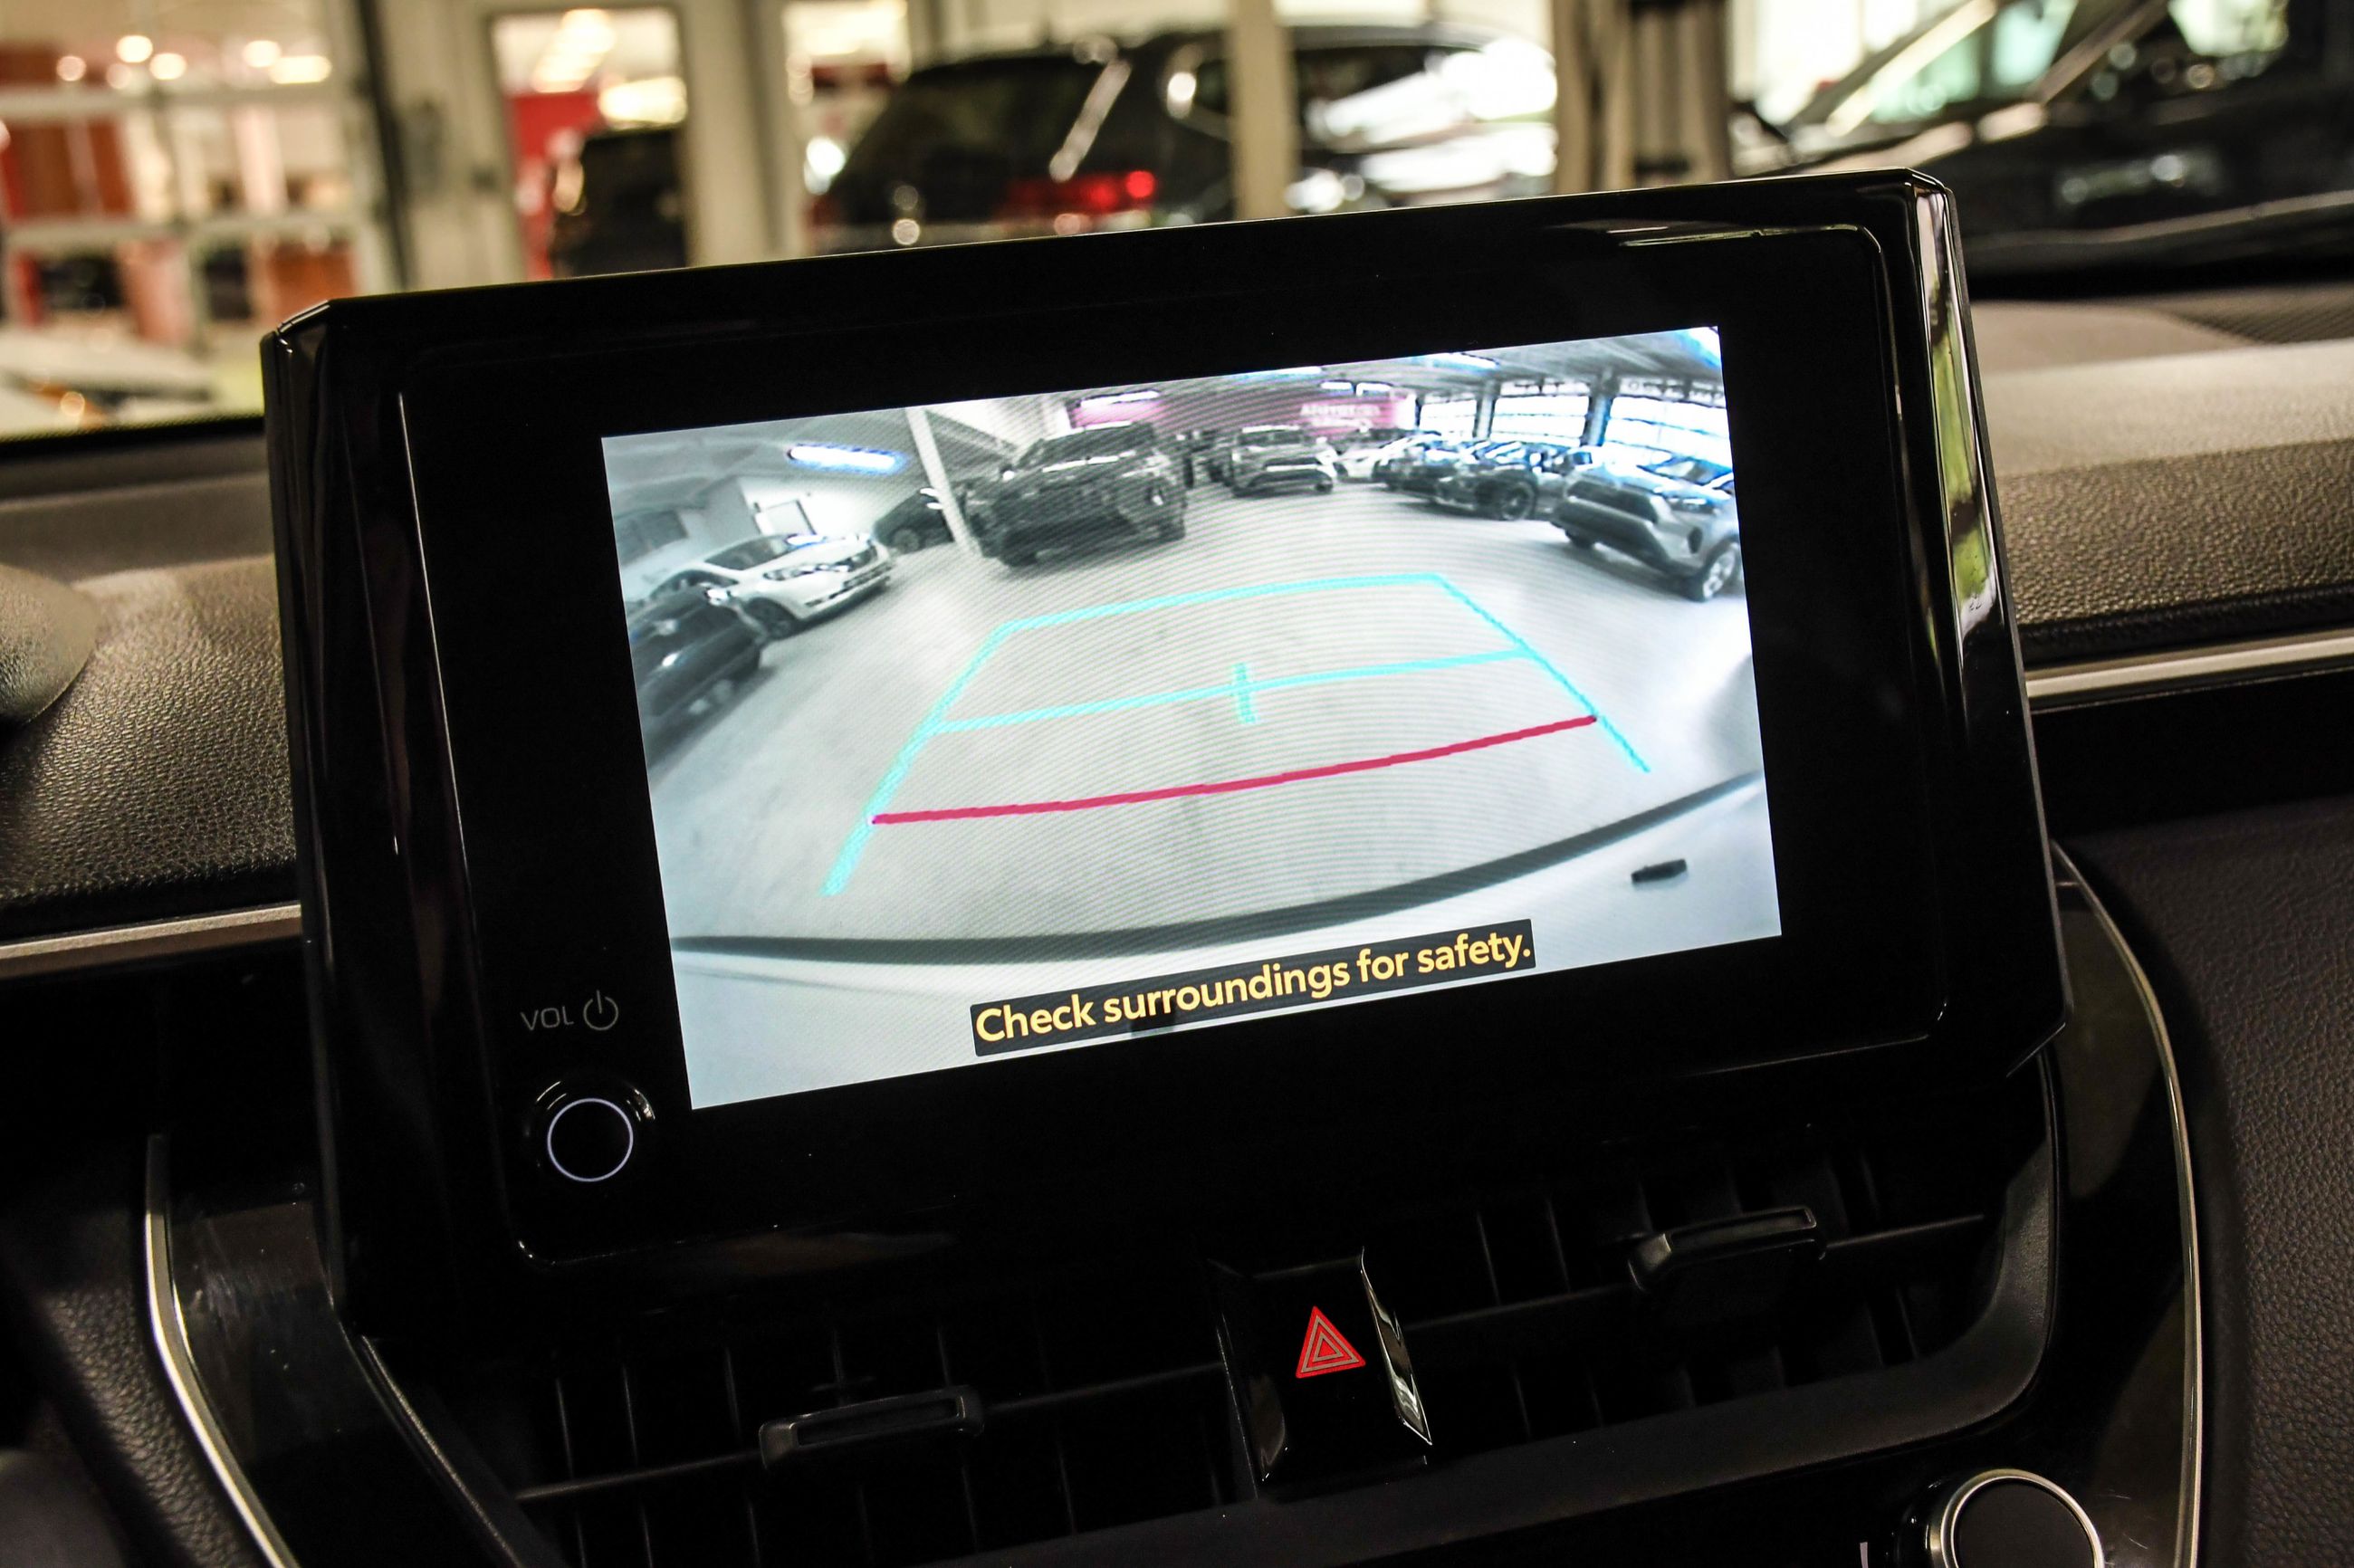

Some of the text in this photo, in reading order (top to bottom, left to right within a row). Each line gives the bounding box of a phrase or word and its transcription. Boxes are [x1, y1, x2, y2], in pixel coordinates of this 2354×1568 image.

[520, 1005, 575, 1031] VOL
[974, 931, 1533, 1043] Check surroundings for safety.
